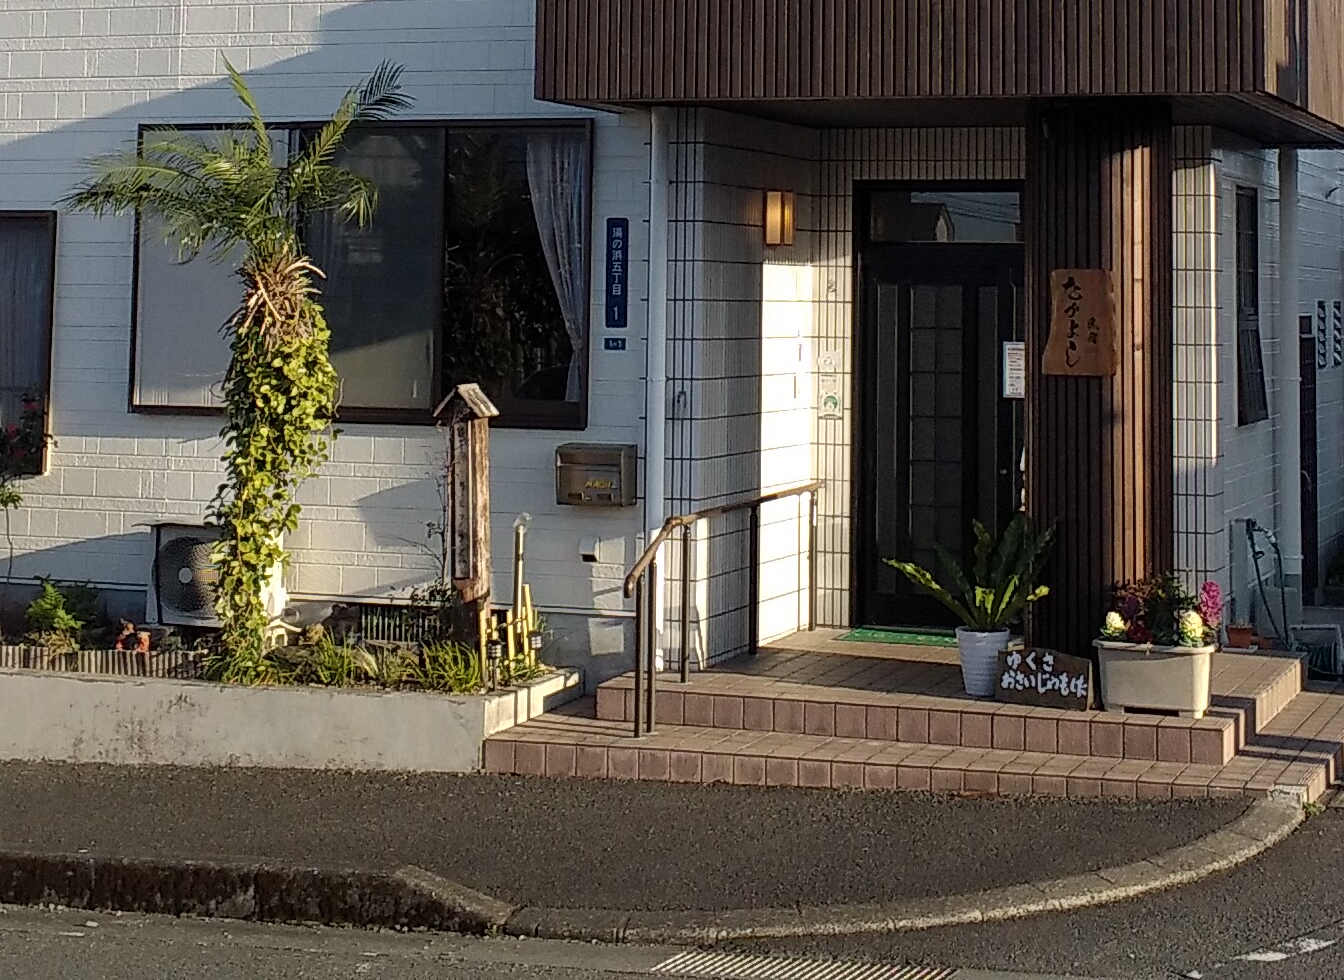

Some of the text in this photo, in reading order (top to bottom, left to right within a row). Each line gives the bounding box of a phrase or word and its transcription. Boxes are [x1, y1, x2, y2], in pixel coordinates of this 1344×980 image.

[612, 305, 619, 321] 1
[1061, 276, 1083, 368] たかよし
[1006, 650, 1054, 672] ゆくさ
